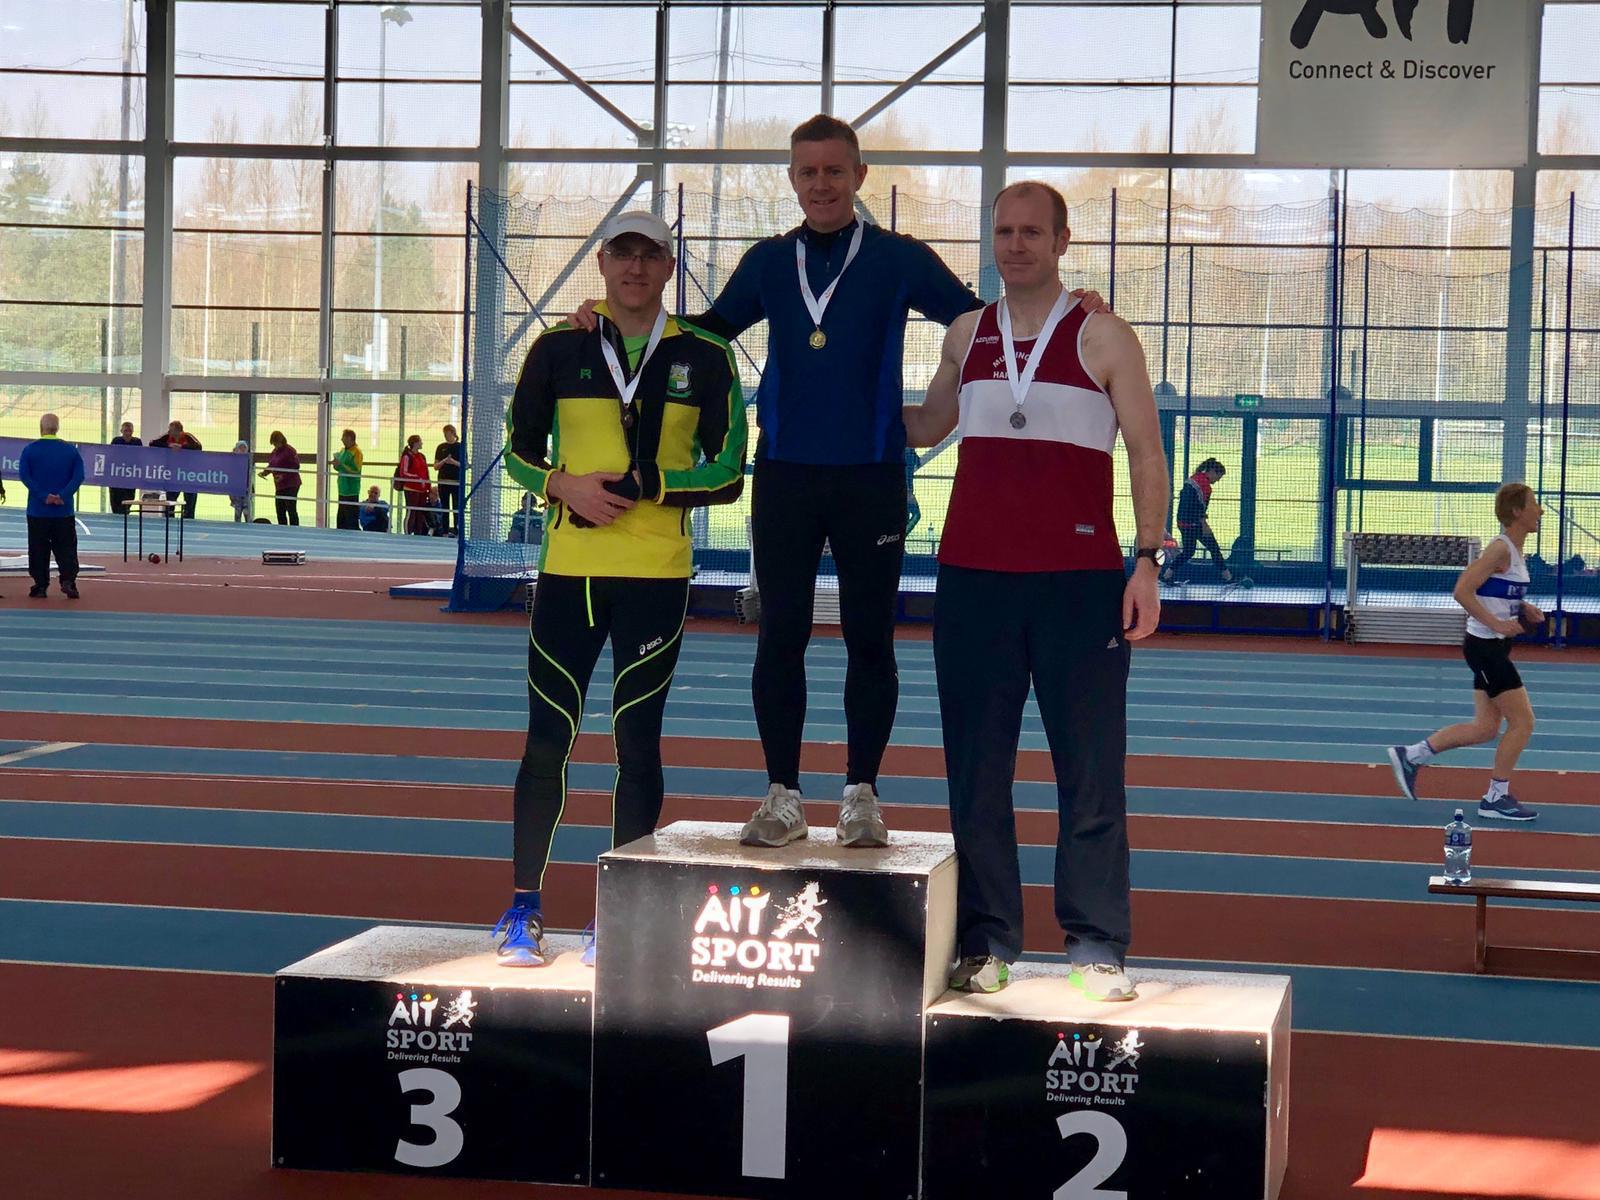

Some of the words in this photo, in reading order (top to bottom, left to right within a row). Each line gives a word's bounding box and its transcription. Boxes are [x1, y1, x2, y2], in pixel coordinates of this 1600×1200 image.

[1289, 60, 1373, 79] Connect
[1380, 60, 1396, 79] &
[1403, 60, 1496, 79] Discover
[110, 463, 142, 478] Irish
[145, 464, 172, 480] Life
[176, 467, 229, 484] health
[694, 885, 771, 936] AIT
[691, 936, 820, 972] SPORT
[692, 969, 756, 989] Delivering
[757, 973, 802, 989] Results
[388, 993, 439, 1027] AIT
[386, 1028, 473, 1052] SPORT
[1048, 1033, 1103, 1068] AIT
[387, 1051, 430, 1063] Delivering
[431, 1053, 461, 1063] Results
[706, 1013, 790, 1179] 1
[1045, 1069, 1139, 1094] SPORT
[1046, 1092, 1092, 1105] Delivering
[1093, 1095, 1126, 1106] Results
[394, 1067, 464, 1168] 3
[1053, 1110, 1128, 1200] 2
